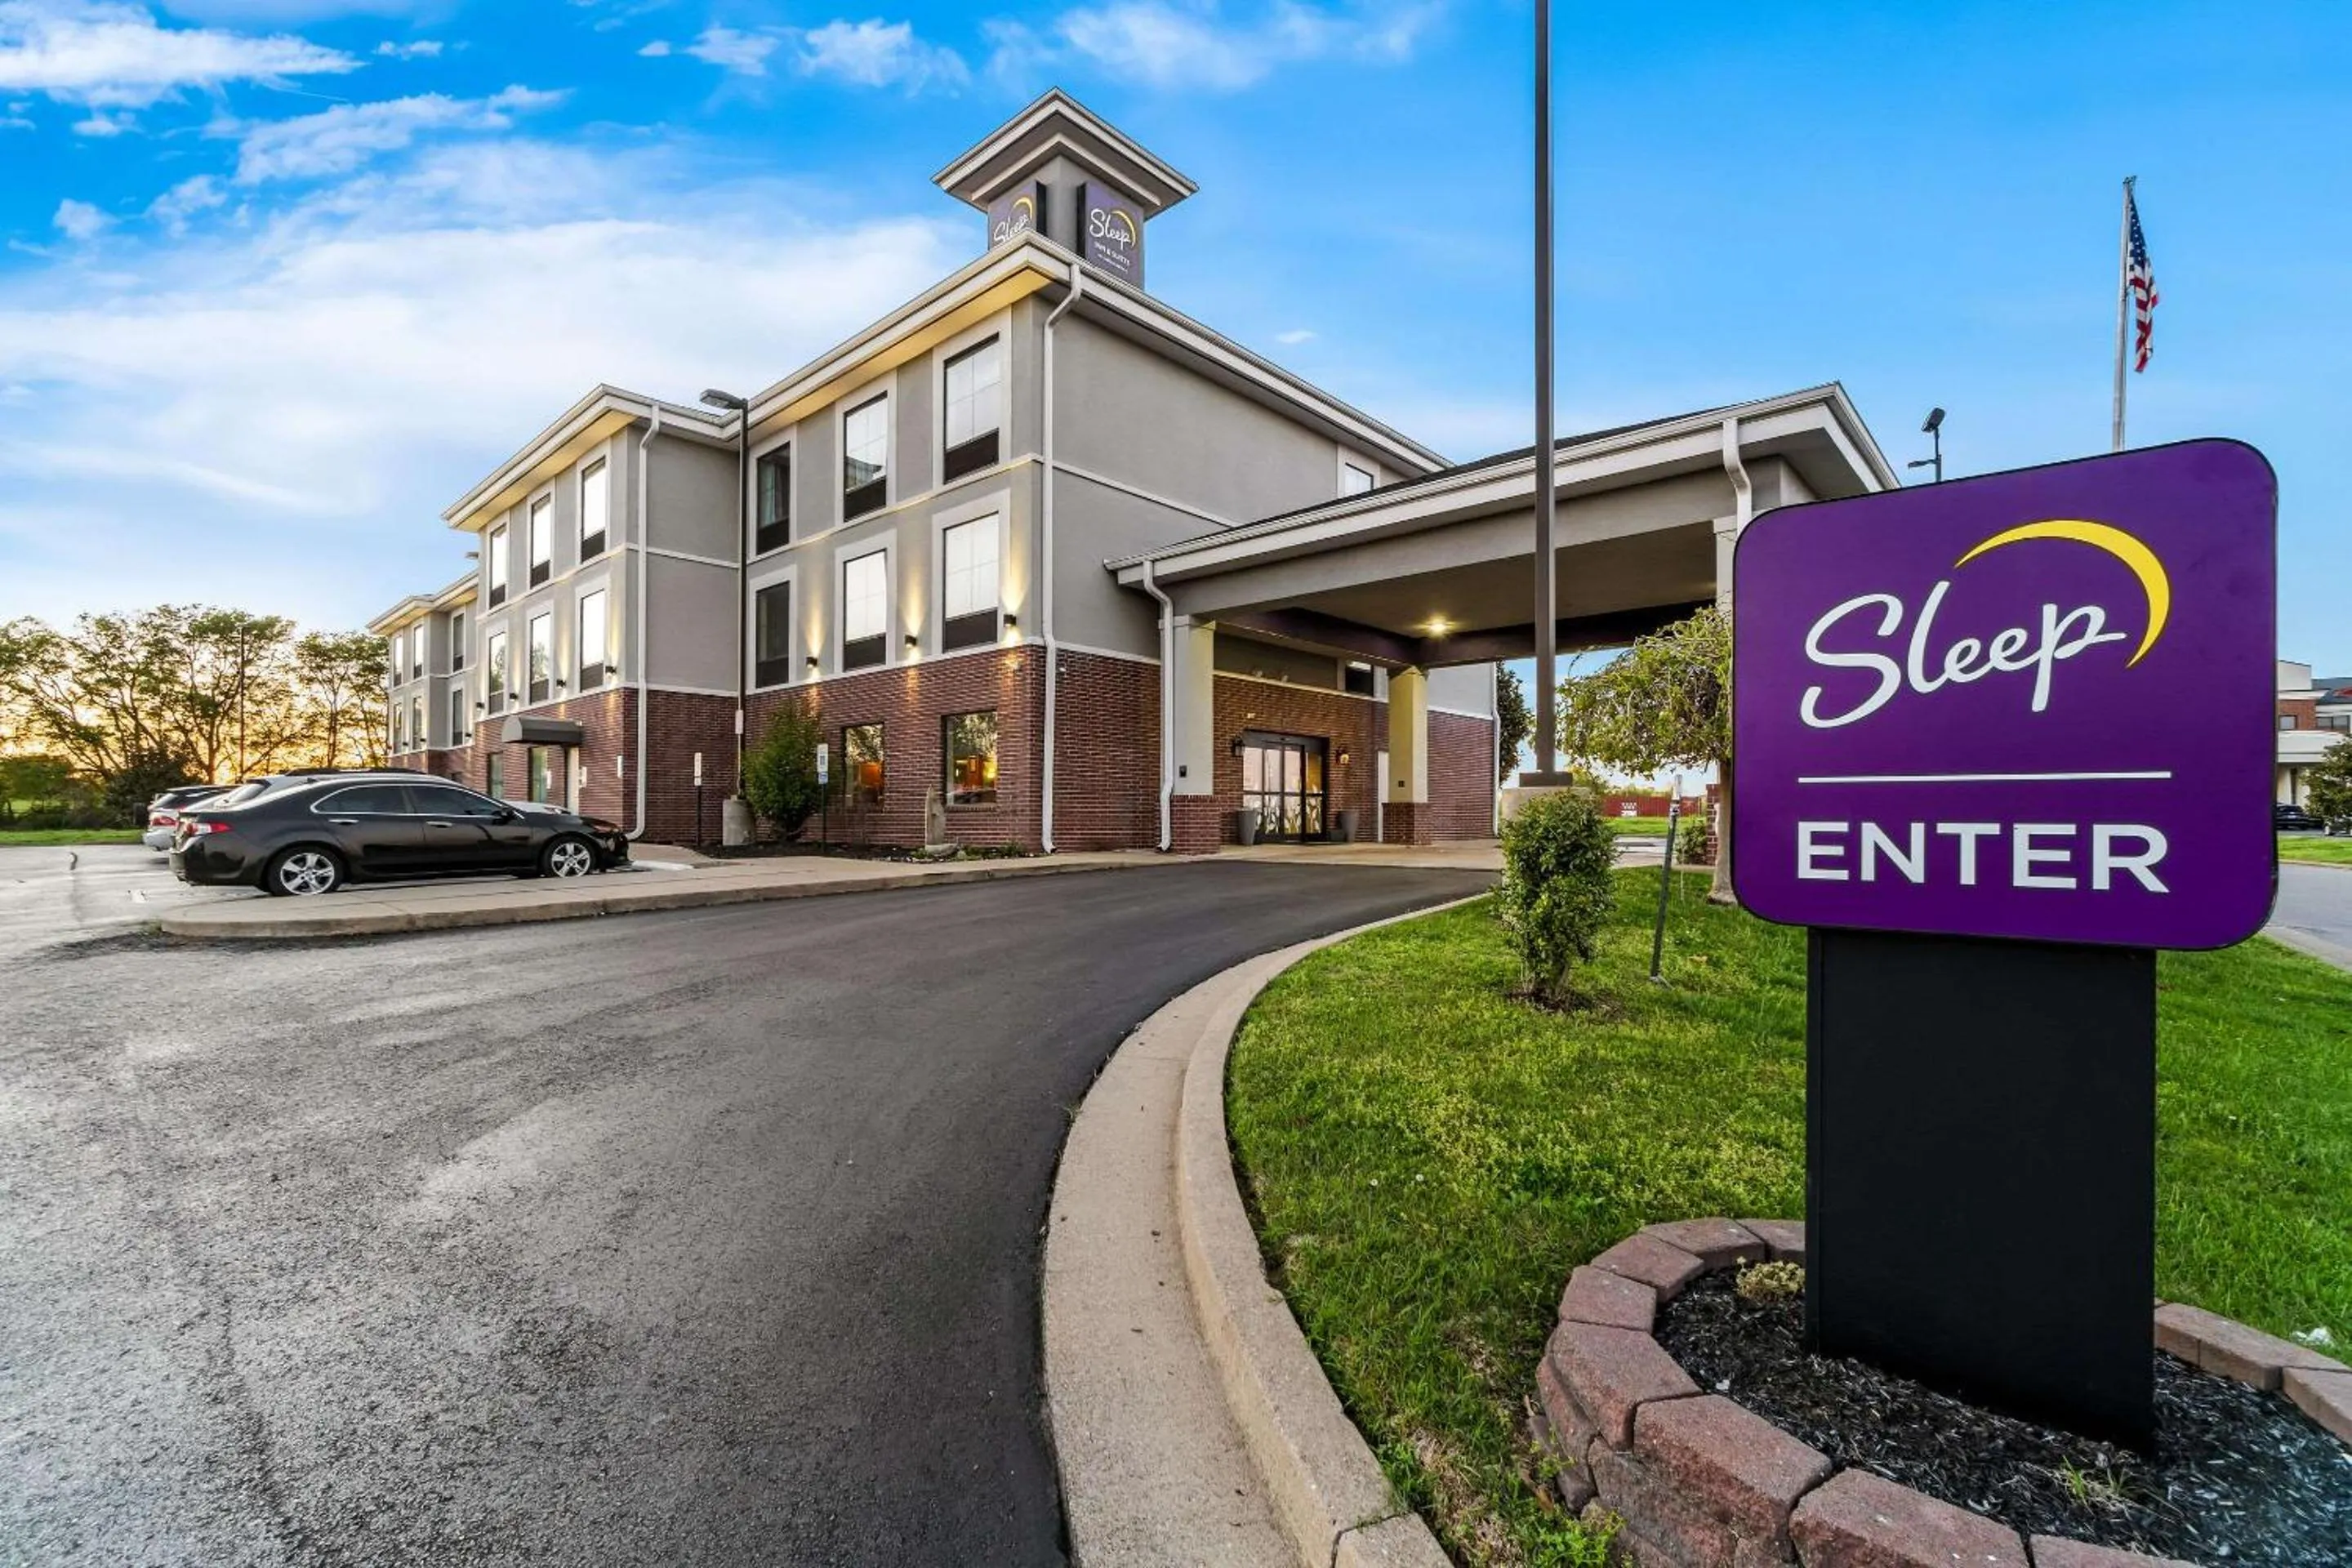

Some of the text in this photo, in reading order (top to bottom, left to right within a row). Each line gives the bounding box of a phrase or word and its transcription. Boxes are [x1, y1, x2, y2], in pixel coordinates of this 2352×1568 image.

[1089, 207, 1131, 252] Sleep
[1800, 581, 2127, 728] Sleep
[1797, 821, 2170, 893] ENTER
